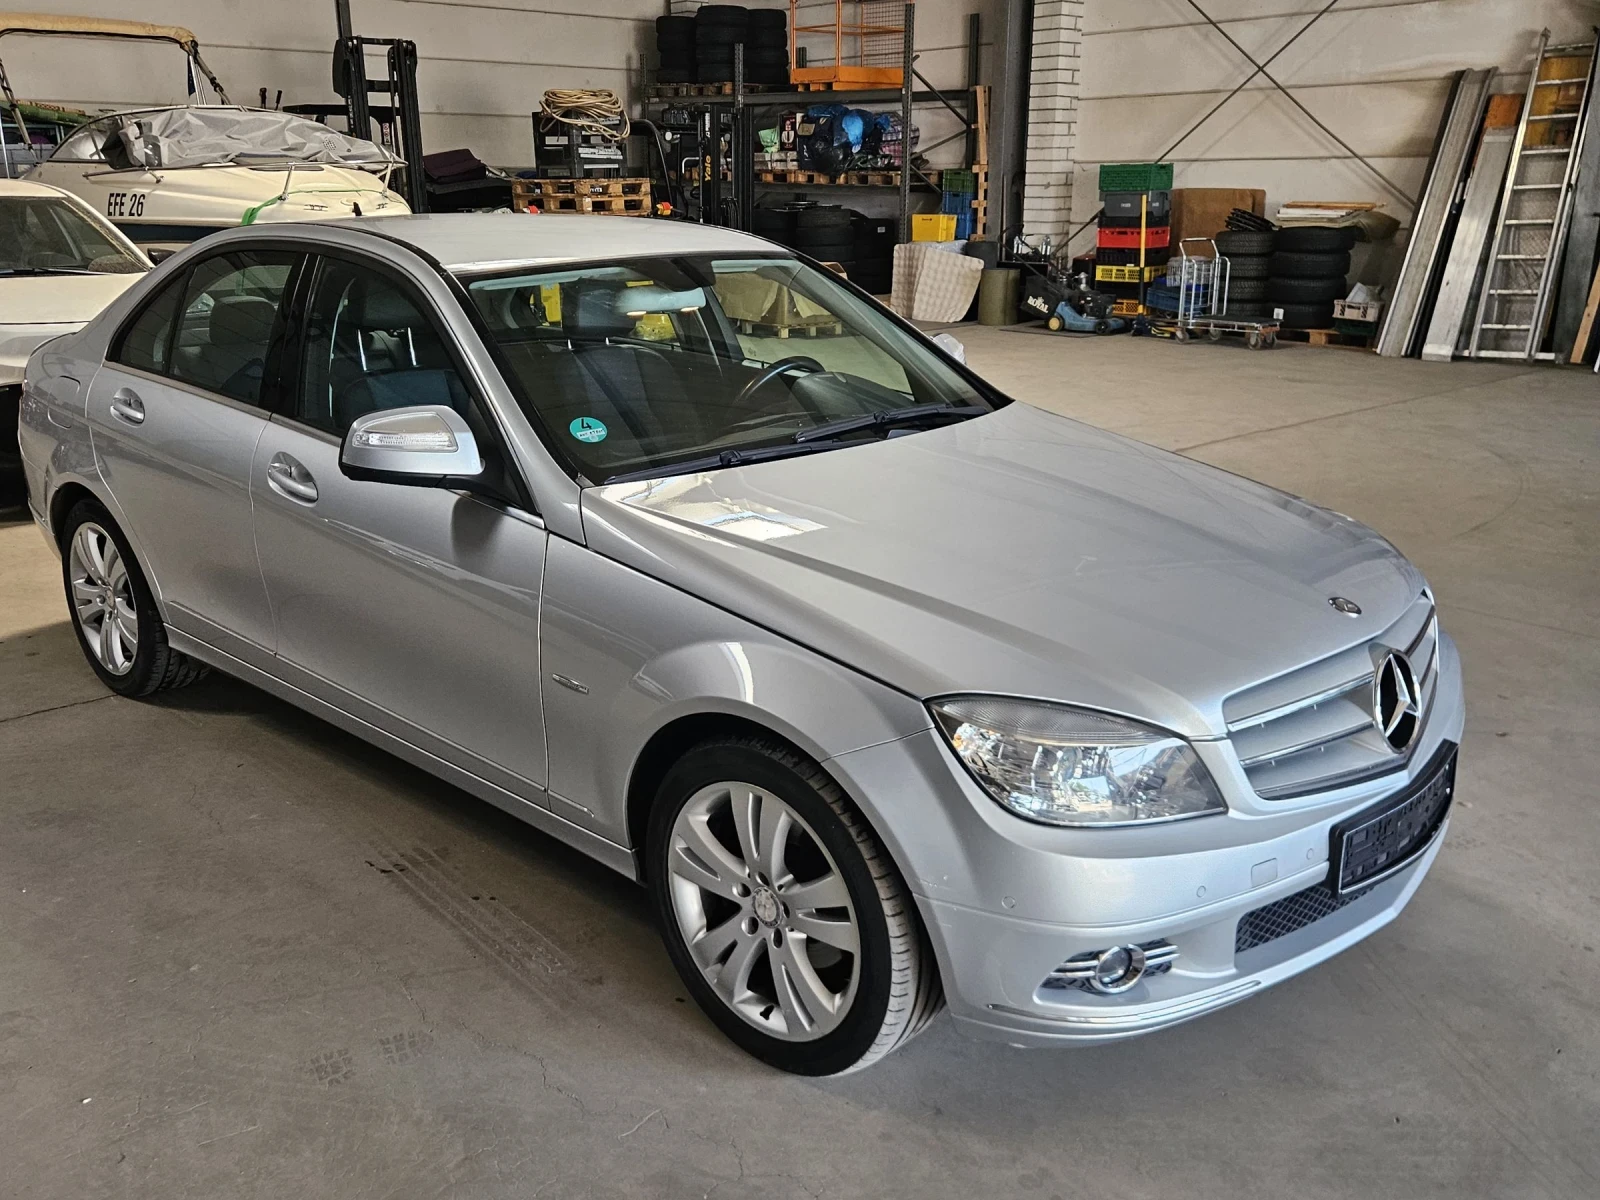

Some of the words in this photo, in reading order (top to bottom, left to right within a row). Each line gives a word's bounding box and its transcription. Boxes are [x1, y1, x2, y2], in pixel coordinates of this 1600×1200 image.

[107, 193, 127, 216] EFE
[128, 193, 146, 217] 26
[581, 418, 592, 430] 4
